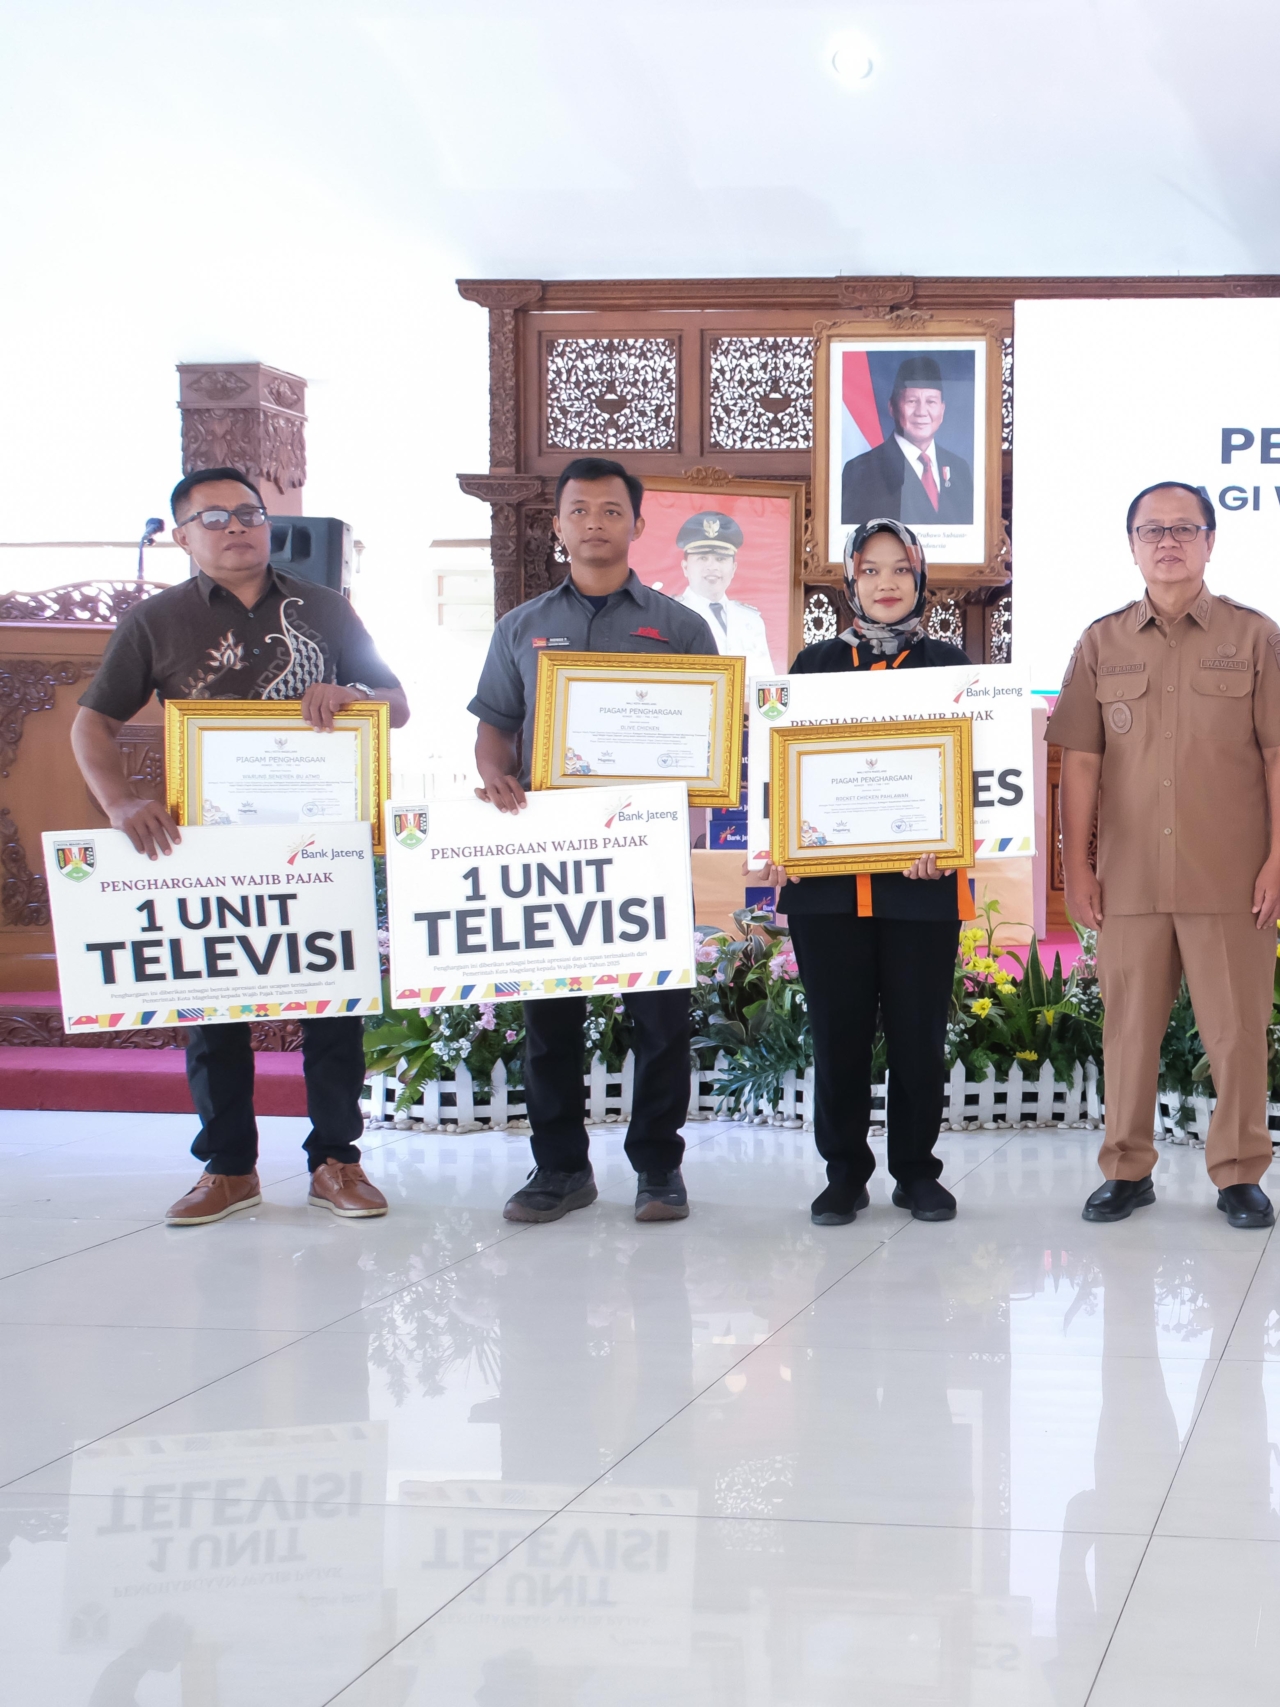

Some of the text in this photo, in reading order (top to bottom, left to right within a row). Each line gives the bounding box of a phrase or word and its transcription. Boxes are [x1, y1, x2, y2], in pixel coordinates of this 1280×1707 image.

[966, 686, 1023, 699] Bank Jateng
[629, 708, 682, 716] PENGHARGAAN
[268, 756, 326, 764] PENGHARGAAN
[860, 774, 912, 784] PENGHARGAAN
[618, 808, 678, 823] Bank Jateng
[301, 846, 364, 862] Bank Jateng
[430, 834, 648, 860] PENGHARGAAN WAJIB PAJAK
[100, 871, 334, 894] PENGHARGAAN WAJIB PAJAK
[462, 858, 613, 902] 1 UNIT
[136, 894, 298, 933] 1 UNIT
[414, 896, 666, 957] TELEVISI
[86, 929, 356, 986] TELEVISI
